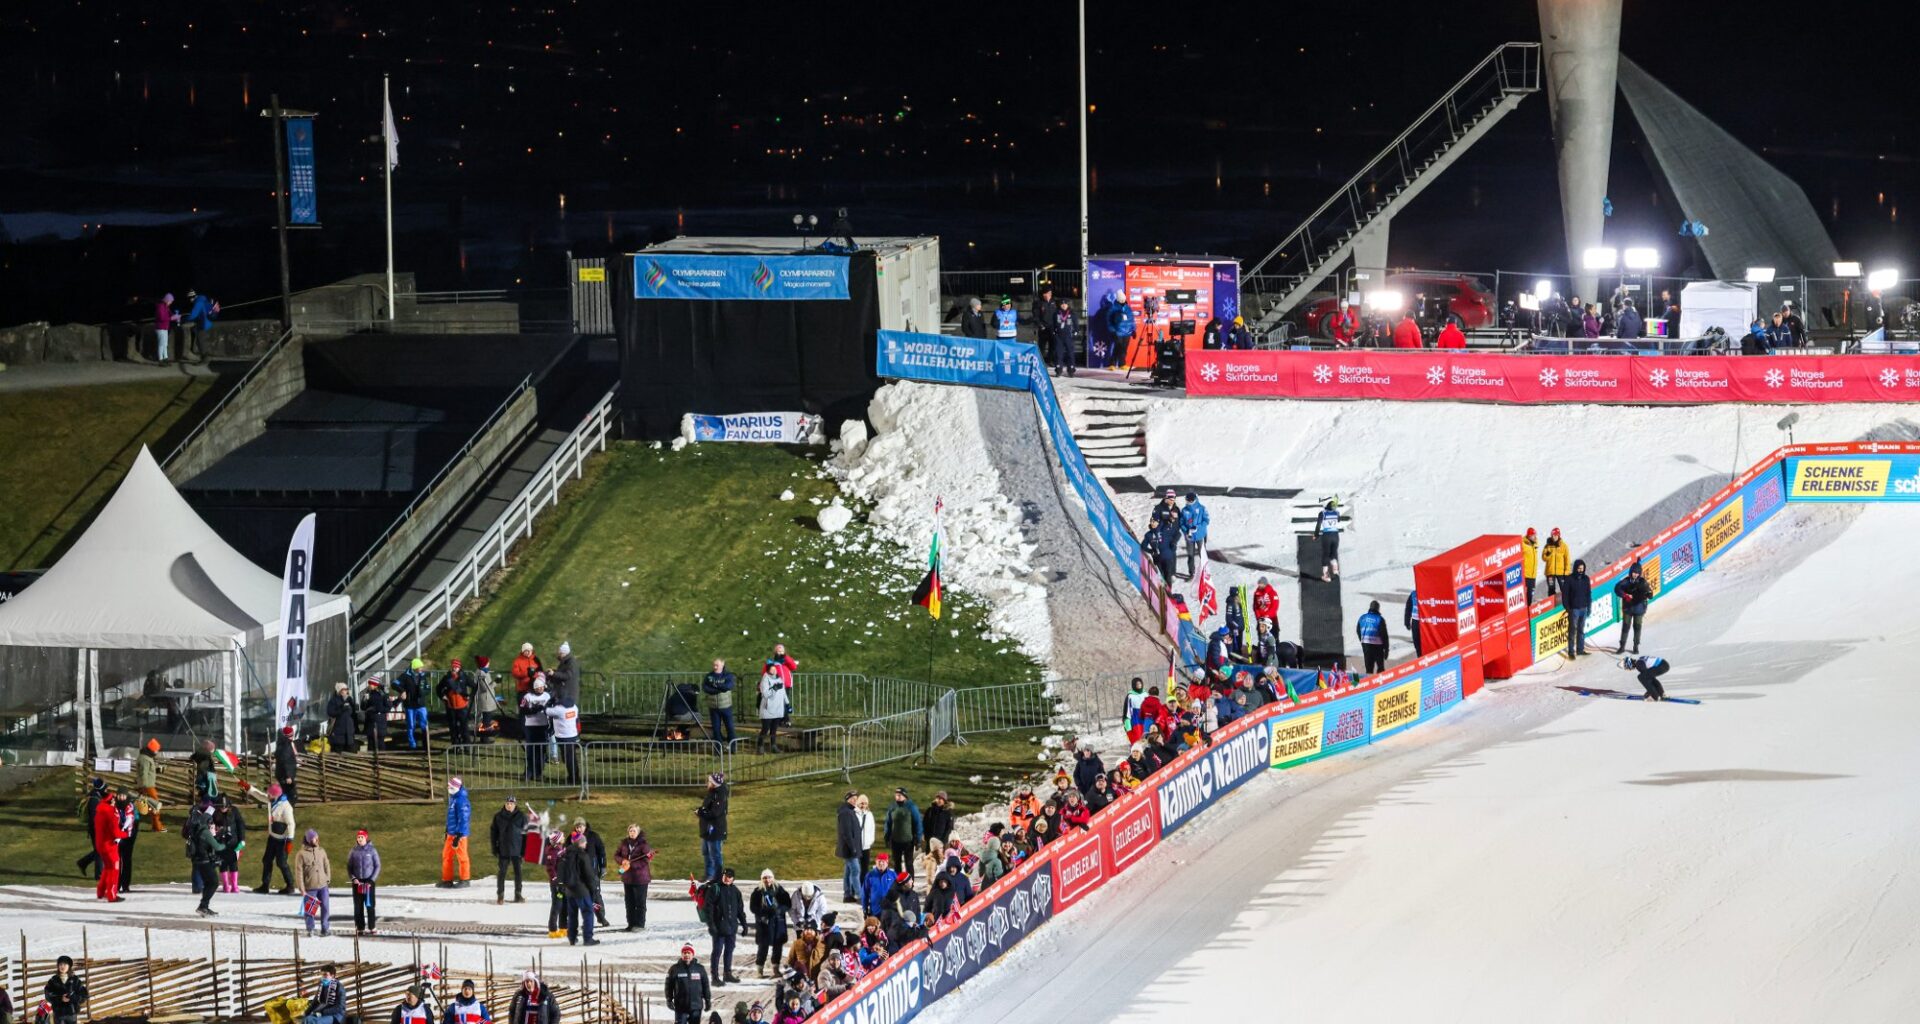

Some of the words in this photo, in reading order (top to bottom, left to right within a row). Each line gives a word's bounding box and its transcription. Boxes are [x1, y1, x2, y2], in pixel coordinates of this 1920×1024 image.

[672, 269, 727, 277] OLYMPIAPARKEN
[780, 269, 835, 277] OLYMPIAPARKEN
[1163, 269, 1210, 280] VIESSMANN
[903, 342, 947, 355] WORLD
[949, 346, 975, 358] CUP
[902, 354, 994, 371] LILLEHAMMER
[1226, 363, 1260, 374] Norges
[1338, 365, 1373, 376] Norges
[1451, 366, 1486, 377] Norges
[1565, 368, 1599, 379] Norges
[1675, 368, 1709, 379] Norges
[1791, 368, 1825, 379] Norges
[1225, 372, 1278, 382] Skiforbund
[1338, 374, 1390, 385] Skiforbund
[1451, 375, 1504, 386] Skiforbund
[1564, 378, 1617, 388] Skiforbund
[1675, 378, 1728, 388] Skiforbund
[1790, 378, 1843, 388] Skiforbund
[725, 416, 782, 428] MARIUS
[726, 430, 749, 439] FAN
[751, 430, 782, 439] CLUB
[1804, 466, 1864, 478] SCHENKE
[1802, 480, 1879, 492] ERLEBNISSE
[1705, 510, 1733, 540] SCHENKE
[1705, 518, 1741, 554] ERLEBNISSE
[1485, 543, 1521, 567] VIESSMANN
[1506, 568, 1520, 582] HYLO
[1418, 598, 1455, 607] VIESSMANN
[1458, 590, 1473, 604] HYLO
[286, 549, 307, 679] BAR
[1420, 616, 1457, 625] VIESSMANN
[1377, 690, 1409, 713] SCHENKE
[1336, 708, 1363, 728] JOCHEN
[1376, 705, 1417, 729] ERLEBNISSE
[1276, 722, 1310, 743] SCHENKE
[1326, 722, 1364, 745] SCHWEIZER
[1274, 735, 1319, 759] ERLEBNISSE
[1115, 813, 1151, 852] BILDELER.NO
